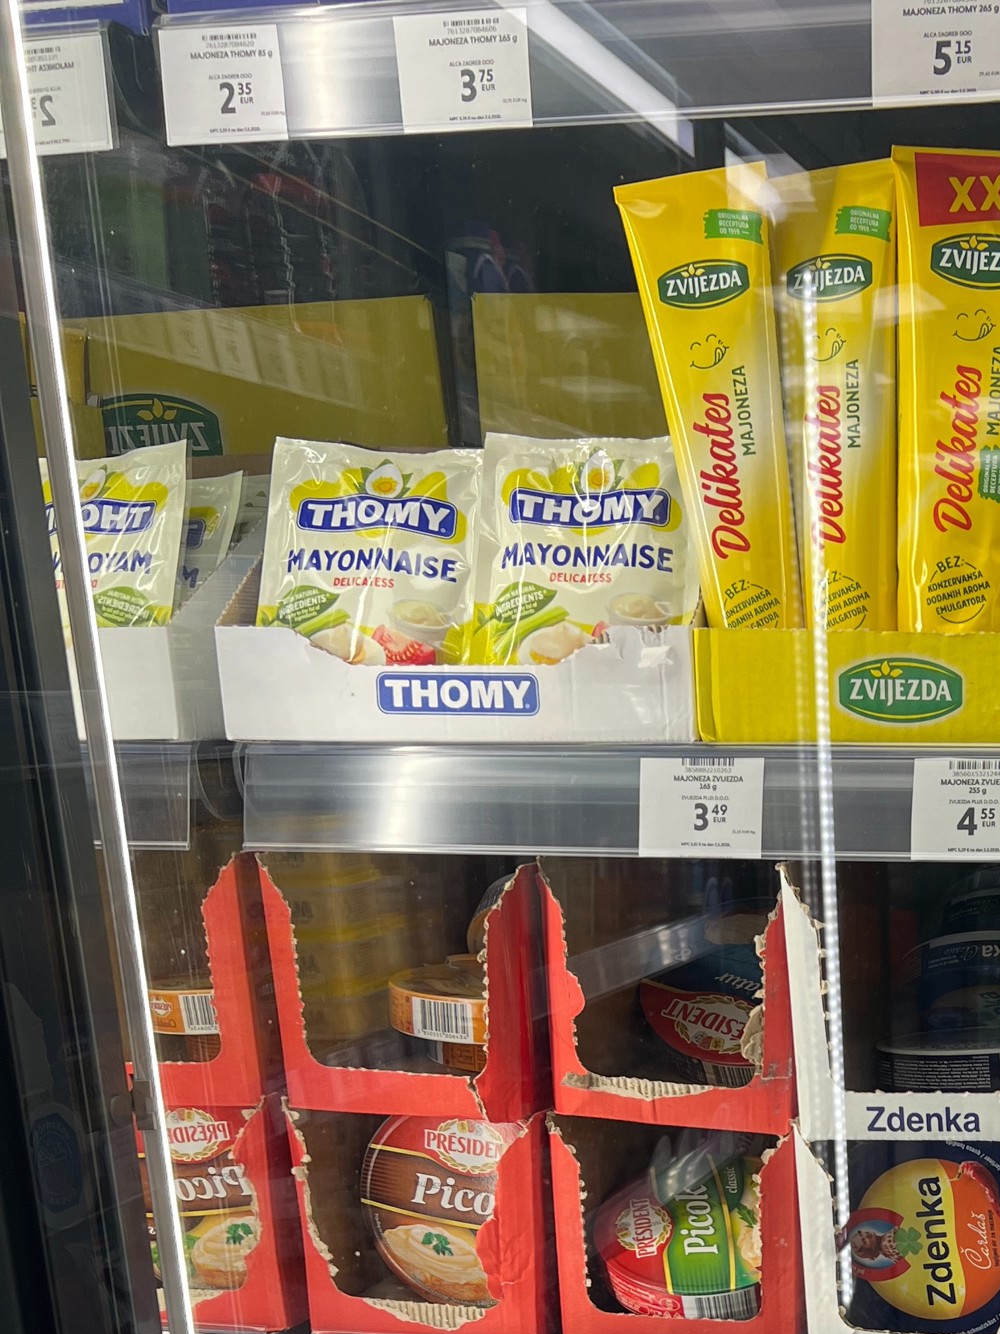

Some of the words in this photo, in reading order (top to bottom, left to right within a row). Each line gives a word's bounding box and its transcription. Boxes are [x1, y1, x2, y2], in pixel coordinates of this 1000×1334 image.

[933, 40, 951, 75] 5
[955, 40, 971, 54] 15
[219, 82, 236, 114] 2
[238, 82, 252, 95] 35
[460, 69, 477, 102] 3
[479, 69, 493, 82] 75
[666, 270, 742, 298] ZVIJEZDA
[793, 266, 865, 291] ZVIJEZDA
[731, 365, 757, 456] MAJONEZA
[845, 359, 861, 448] MAJONEZA
[933, 364, 983, 533] Delikates
[693, 393, 751, 560] Delikates
[805, 385, 846, 550] Delikates
[307, 499, 450, 533] THOMY
[517, 492, 661, 523] THOMY
[287, 547, 458, 583] MAYONNAISE
[501, 542, 673, 572] MAYONNAISE
[936, 555, 965, 574] BEZ:
[333, 576, 395, 589] DELICATESS
[549, 572, 612, 584] DELICATESS
[927, 570, 984, 593] KONZERVANSA
[926, 589, 962, 606] DODANIH
[962, 581, 991, 598] AROMA
[935, 595, 987, 616] EMULGATORA
[384, 679, 530, 709] THOMY
[850, 678, 952, 707] ZVIJEZDA
[694, 803, 708, 831] 3
[711, 804, 728, 815] 49
[957, 807, 977, 836] 4
[980, 808, 995, 819] 55
[866, 1106, 981, 1133] Zdenka
[628, 1199, 657, 1258] PRÉSIDENT
[915, 1176, 957, 1306] Zdenka
[960, 1211, 993, 1270] Čardaš
